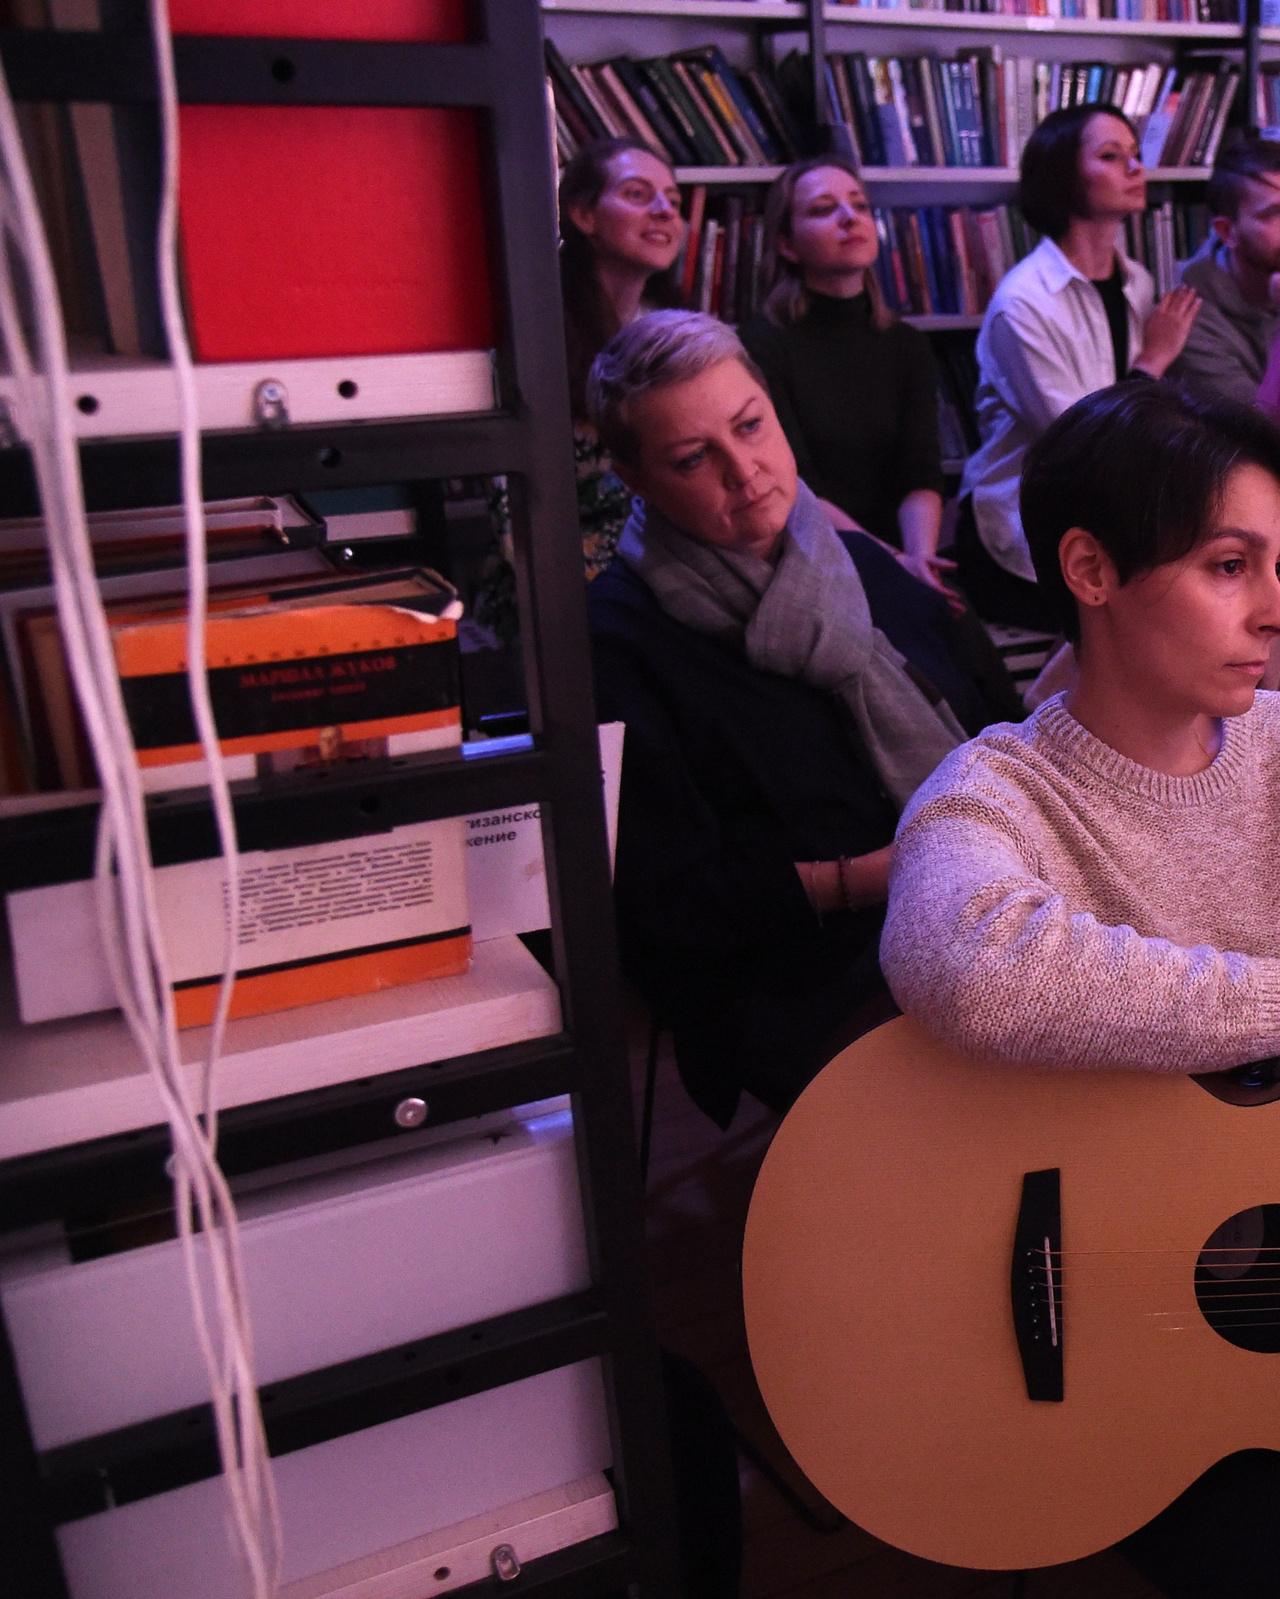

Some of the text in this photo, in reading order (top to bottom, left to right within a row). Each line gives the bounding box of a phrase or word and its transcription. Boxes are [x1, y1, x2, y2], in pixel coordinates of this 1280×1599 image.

[240, 665, 325, 688] МАРШАЛ
[330, 655, 397, 677] ЖУКОВ
[466, 809, 541, 829] изанско
